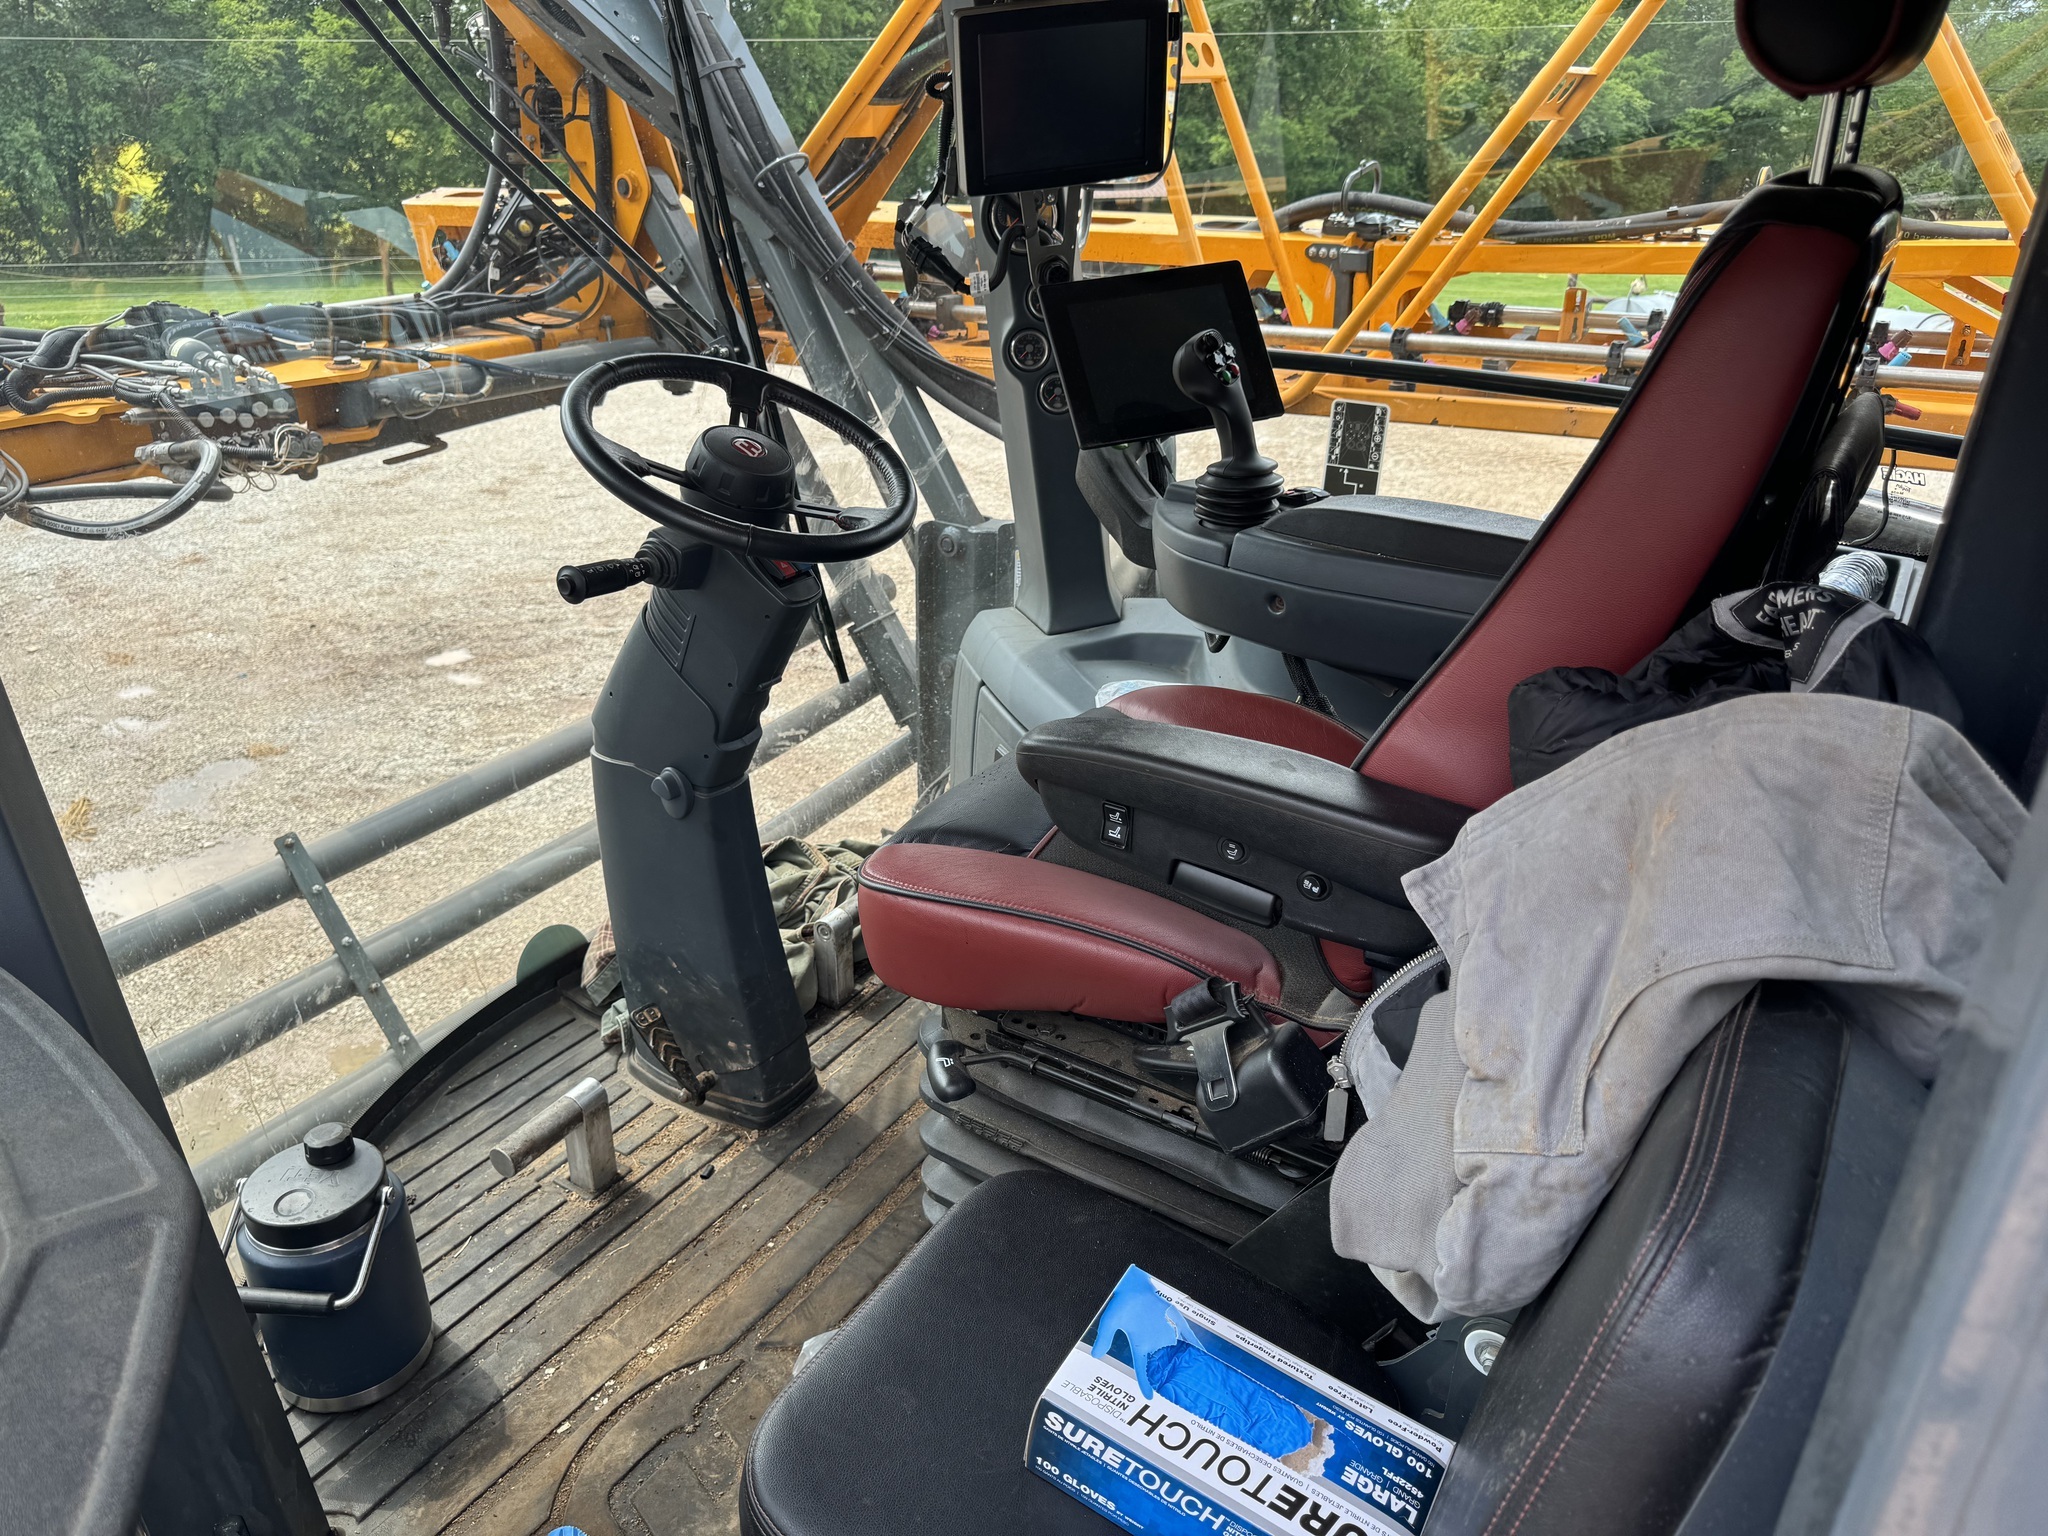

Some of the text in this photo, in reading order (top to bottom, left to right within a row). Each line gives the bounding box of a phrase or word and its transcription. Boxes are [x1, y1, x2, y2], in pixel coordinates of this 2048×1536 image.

[1154, 1289, 1173, 1303] Only
[1190, 1309, 1216, 1326] Single
[1234, 1333, 1276, 1359] Fingertips
[1276, 1356, 1313, 1381] Textured
[1060, 1379, 1122, 1419] DISPOSABLE
[1086, 1382, 1129, 1412] NITRILE
[1092, 1373, 1136, 1404] GLOVES
[1327, 1384, 1373, 1414] Latex-Free
[1189, 1418, 1216, 1437] NITRILO
[1214, 1432, 1225, 1442] DE
[1342, 1419, 1404, 1459] GLOVES
[1386, 1417, 1442, 1453] Powder-Free
[1224, 1437, 1272, 1469] DESECHABLES
[1404, 1454, 1432, 1479] 100
[1036, 1455, 1060, 1475] 100
[1061, 1472, 1117, 1511] GLOVES
[1042, 1410, 1226, 1531] SURETOUCH
[1271, 1464, 1304, 1488] GUANTES
[1348, 1458, 1421, 1509] GRAND GRANDE
[1379, 1465, 1425, 1499] 4522PFL
[1309, 1487, 1344, 1511] JETABLES
[1338, 1465, 1418, 1525] LARGE
[1369, 1523, 1381, 1533] DE
